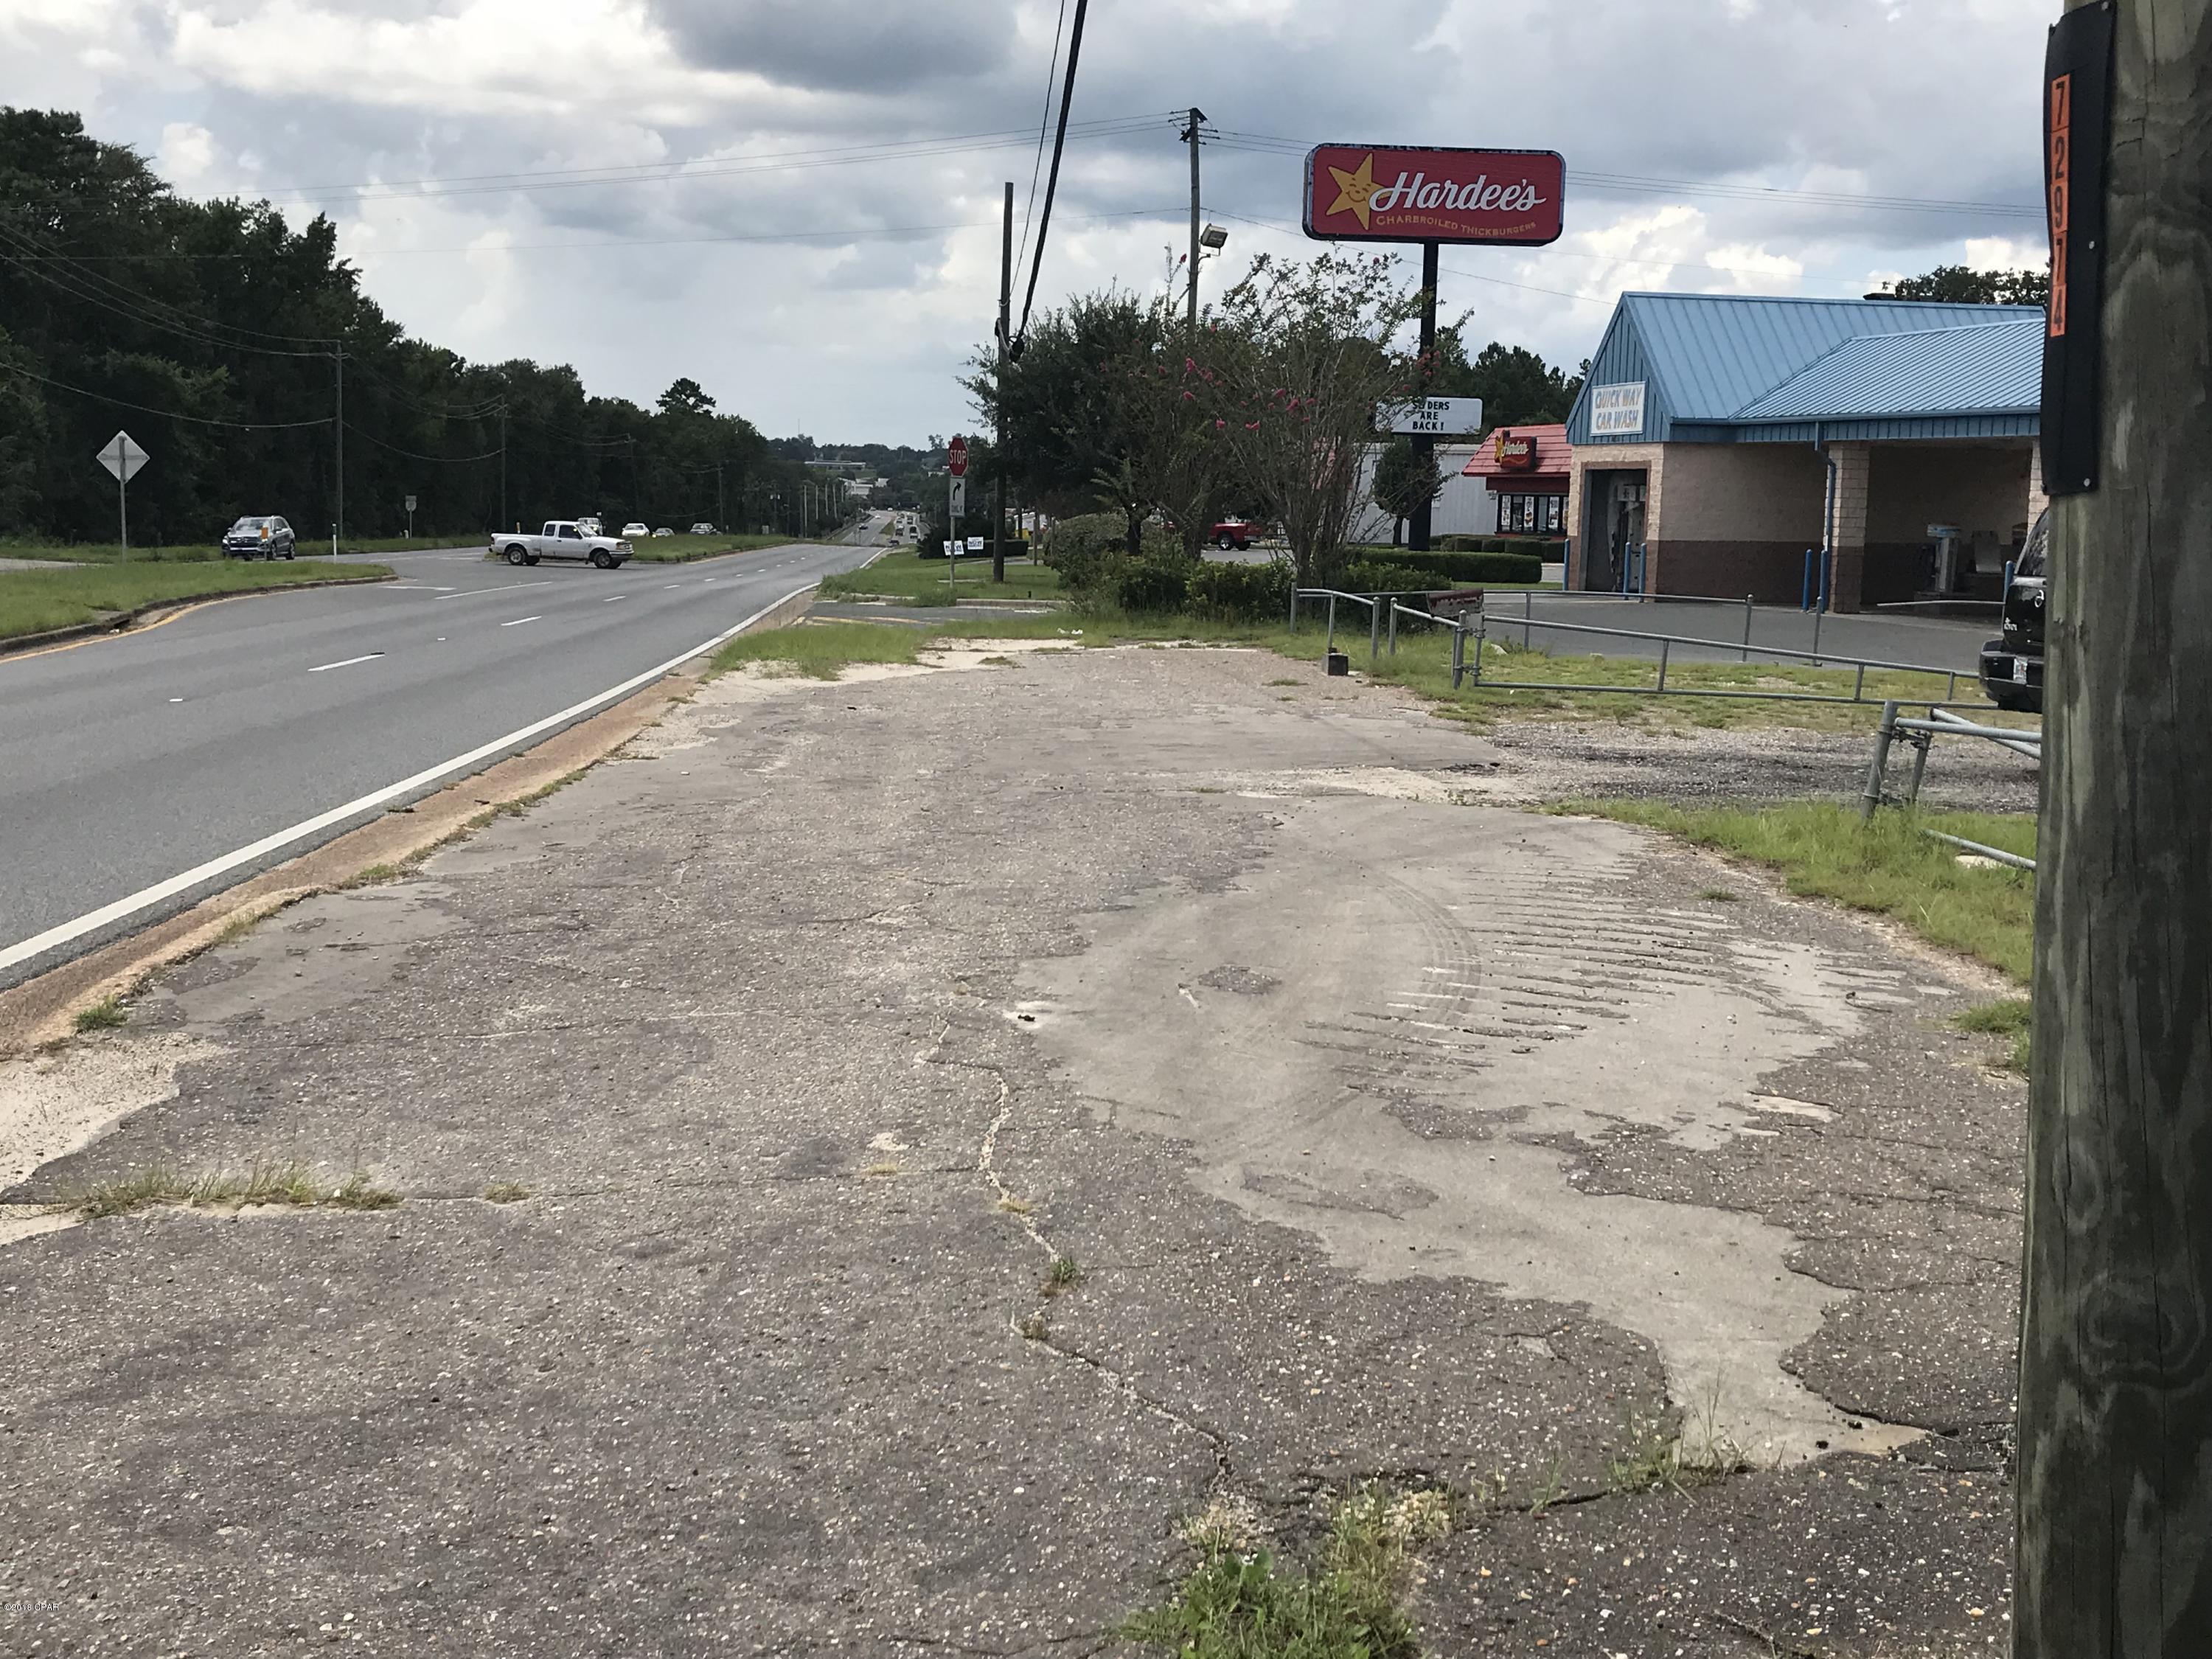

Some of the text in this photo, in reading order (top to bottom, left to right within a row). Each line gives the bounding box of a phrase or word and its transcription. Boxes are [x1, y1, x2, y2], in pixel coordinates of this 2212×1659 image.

[1368, 171, 1547, 212] Hardee's
[2053, 79, 2066, 330] 72974
[1376, 215, 1537, 237] CHARBROILED THICKBURGERS
[1595, 387, 1643, 409] QUICK WAY
[1419, 411, 1439, 420] ARE
[1596, 408, 1639, 431] CAR WASH
[949, 449, 967, 465] STOP
